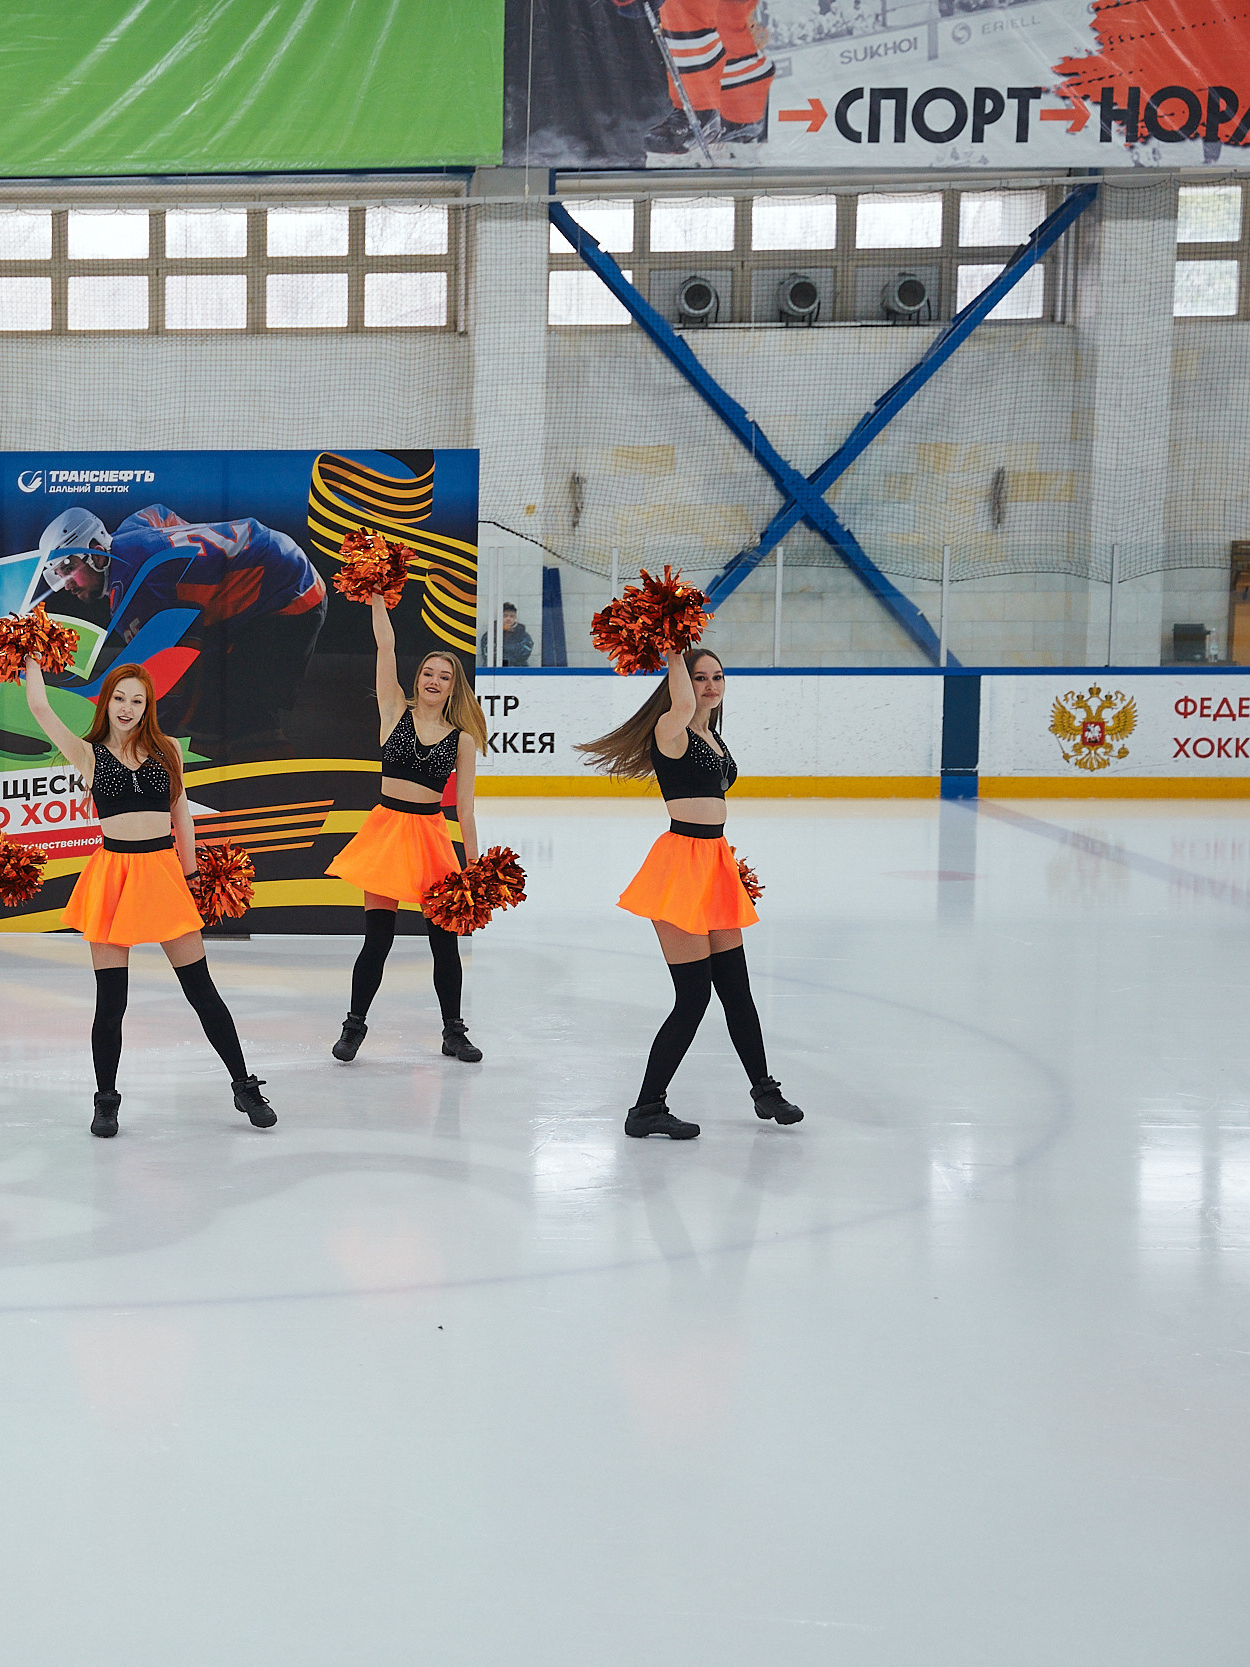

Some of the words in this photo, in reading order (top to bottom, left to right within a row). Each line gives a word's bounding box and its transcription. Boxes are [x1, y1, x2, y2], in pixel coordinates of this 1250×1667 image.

[839, 37, 919, 65] SUKHOI
[835, 86, 1042, 144] СПОРТ
[48, 470, 155, 483] ТРАНСНЕФТЬ
[48, 484, 91, 493] ДАЛЬНИЙ
[94, 484, 130, 493] ВОСТОК
[477, 695, 519, 716] ТР
[1174, 695, 1250, 721] ФЕДЕ
[1173, 737, 1250, 758] ХОКК
